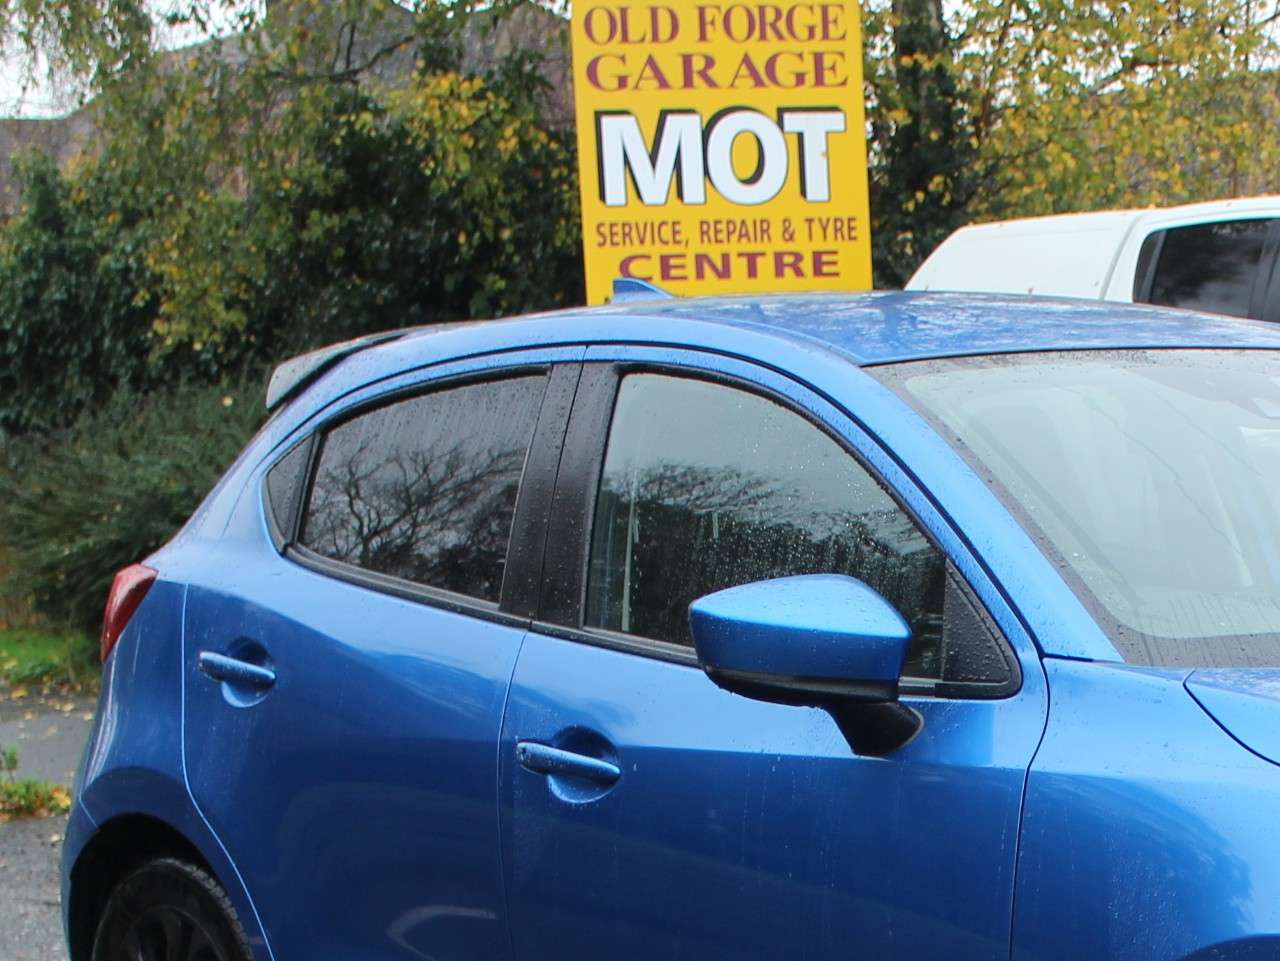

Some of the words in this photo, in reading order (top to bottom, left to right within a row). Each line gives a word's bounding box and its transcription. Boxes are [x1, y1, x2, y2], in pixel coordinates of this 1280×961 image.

[583, 5, 680, 45] OLD
[696, 4, 847, 44] FORGE
[586, 51, 848, 91] GARAGE
[594, 106, 846, 206] MOT
[596, 220, 689, 248] SERVICE,
[700, 218, 772, 244] REPAIR
[782, 218, 796, 242] &
[805, 216, 858, 242] TYRE
[618, 251, 840, 282] CENTRE
